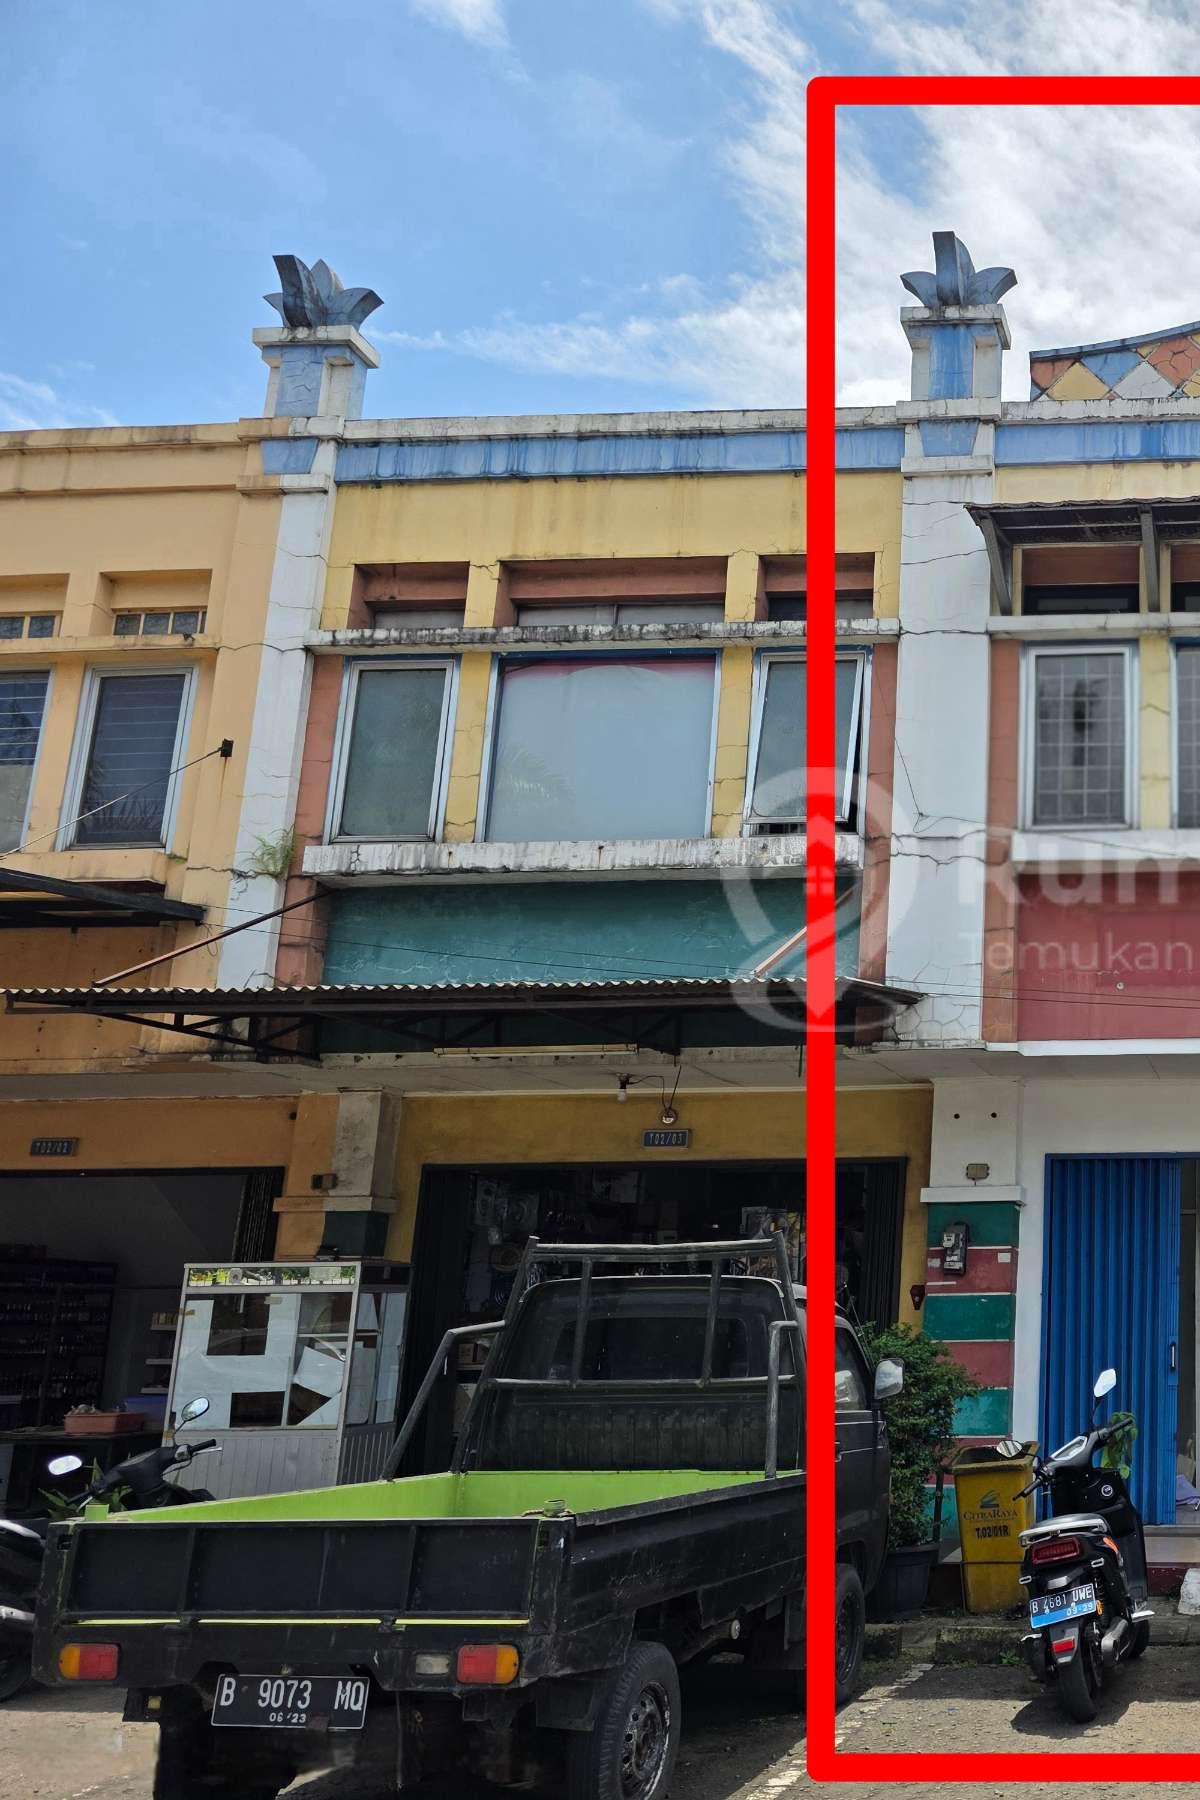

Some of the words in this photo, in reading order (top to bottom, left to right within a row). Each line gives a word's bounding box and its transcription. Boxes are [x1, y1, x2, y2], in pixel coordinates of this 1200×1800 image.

[1032, 1601, 1038, 1613] B
[1072, 1586, 1092, 1602] UWE
[220, 1677, 236, 1706] B
[258, 1679, 312, 1709] 9073
[334, 1680, 365, 1711] MQ
